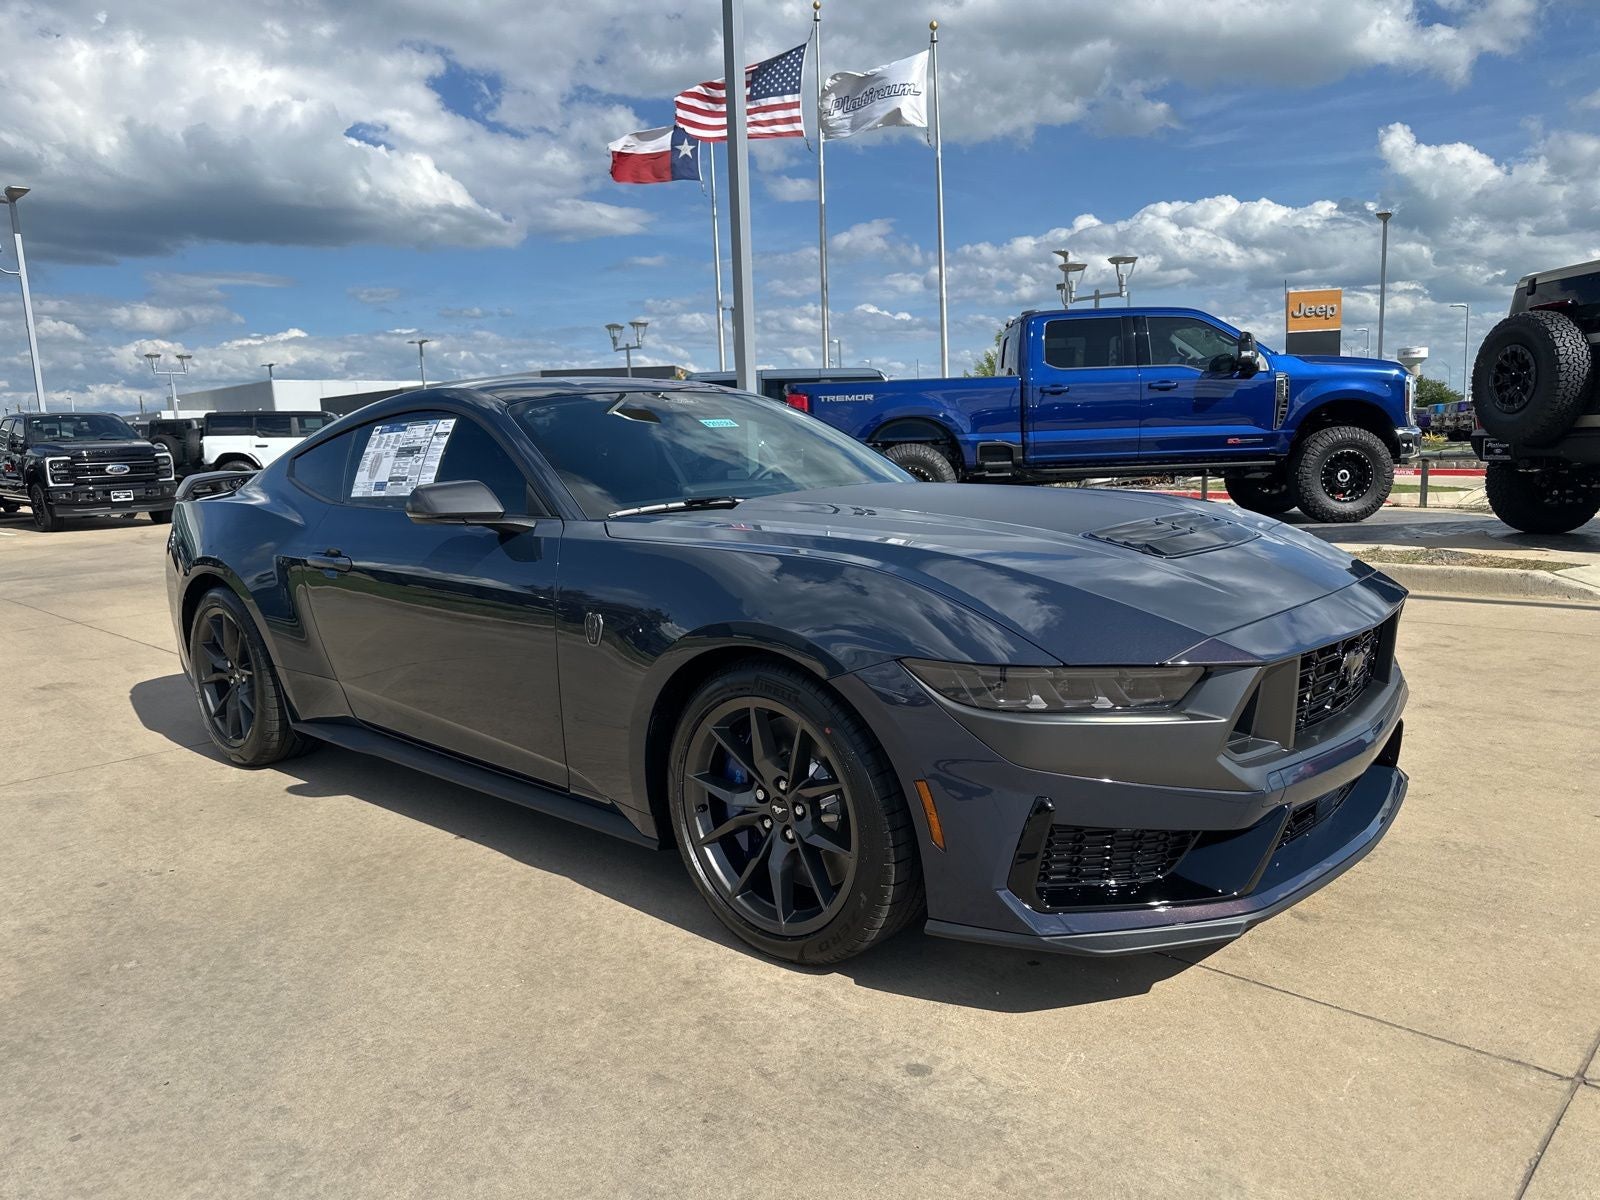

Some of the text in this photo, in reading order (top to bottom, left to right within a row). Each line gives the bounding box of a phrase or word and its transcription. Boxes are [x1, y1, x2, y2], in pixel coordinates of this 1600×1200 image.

[827, 82, 922, 117] Platinum
[1291, 302, 1337, 320] Jeep
[818, 394, 874, 402] TREMOR
